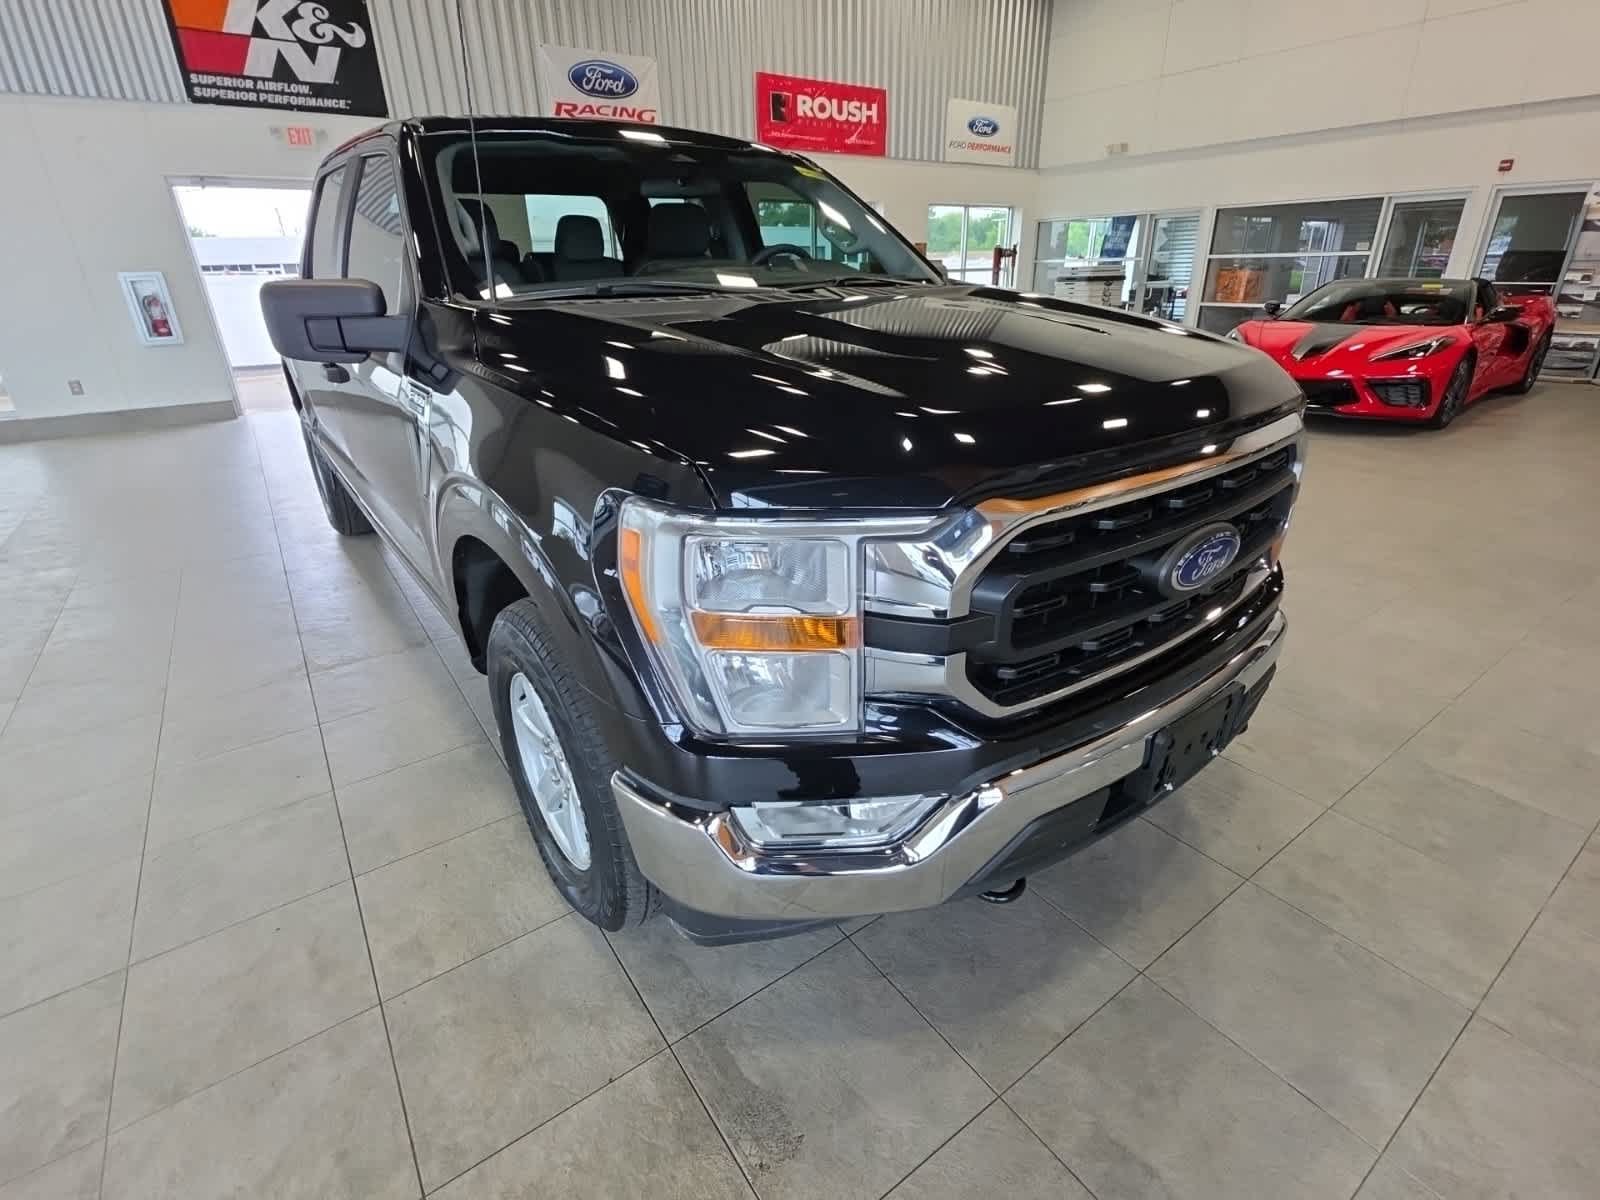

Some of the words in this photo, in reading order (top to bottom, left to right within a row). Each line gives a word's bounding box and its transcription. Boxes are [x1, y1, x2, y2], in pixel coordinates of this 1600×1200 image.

[190, 73, 254, 89] SUPERIOR
[256, 79, 313, 95] AIRFLOW.
[582, 65, 625, 93] Ford
[193, 87, 258, 102] SUPERIOR
[554, 102, 657, 123] RACING
[796, 94, 879, 124] ROUSH
[287, 127, 312, 145] EXIT
[972, 119, 994, 134] Ford
[1192, 545, 1231, 581] Ford
